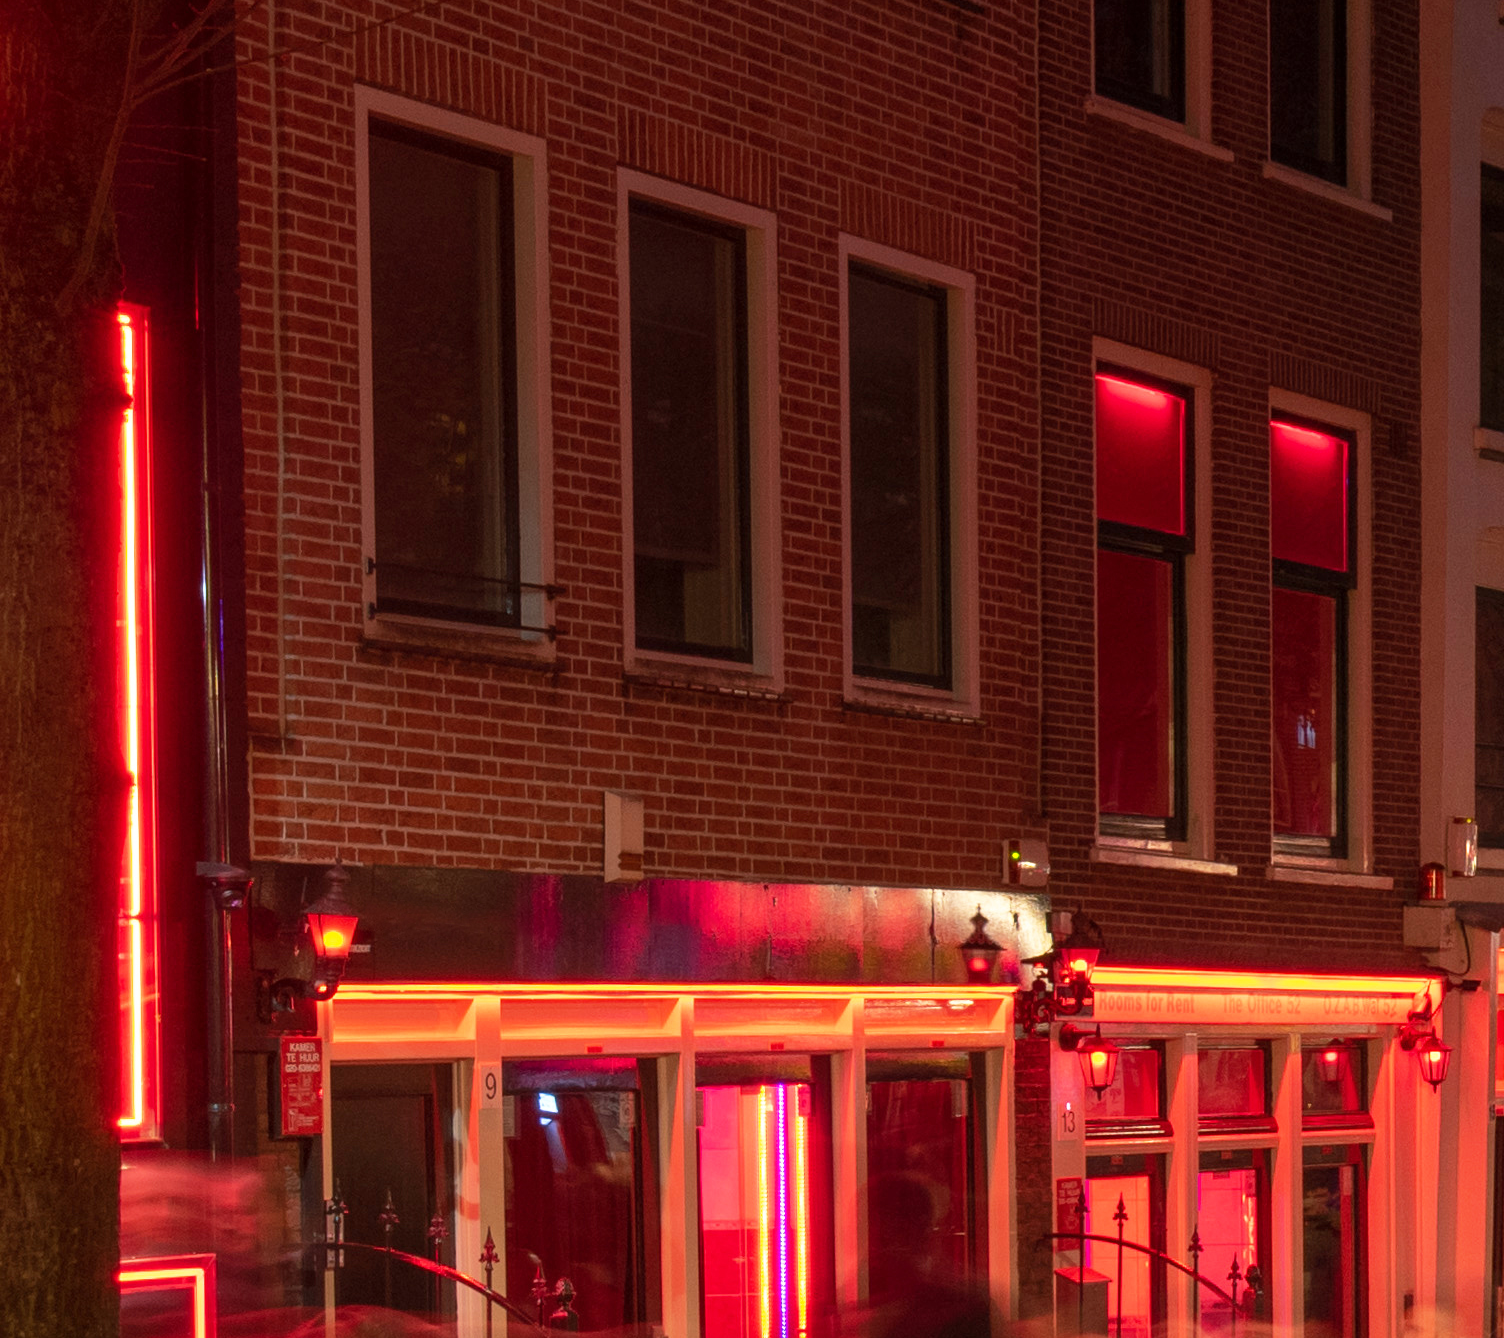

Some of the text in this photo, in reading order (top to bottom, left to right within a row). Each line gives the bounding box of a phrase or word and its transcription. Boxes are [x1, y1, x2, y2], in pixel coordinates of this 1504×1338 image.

[1100, 991, 1142, 1012] Rooms
[1146, 991, 1163, 1012] for
[1166, 993, 1194, 1014] Rent
[1223, 996, 1242, 1013] The
[1248, 996, 1282, 1015] Office
[1287, 997, 1301, 1014] 52
[286, 1052, 297, 1063] TE
[485, 1072, 497, 1100] 9
[1061, 1111, 1076, 1133] 13
